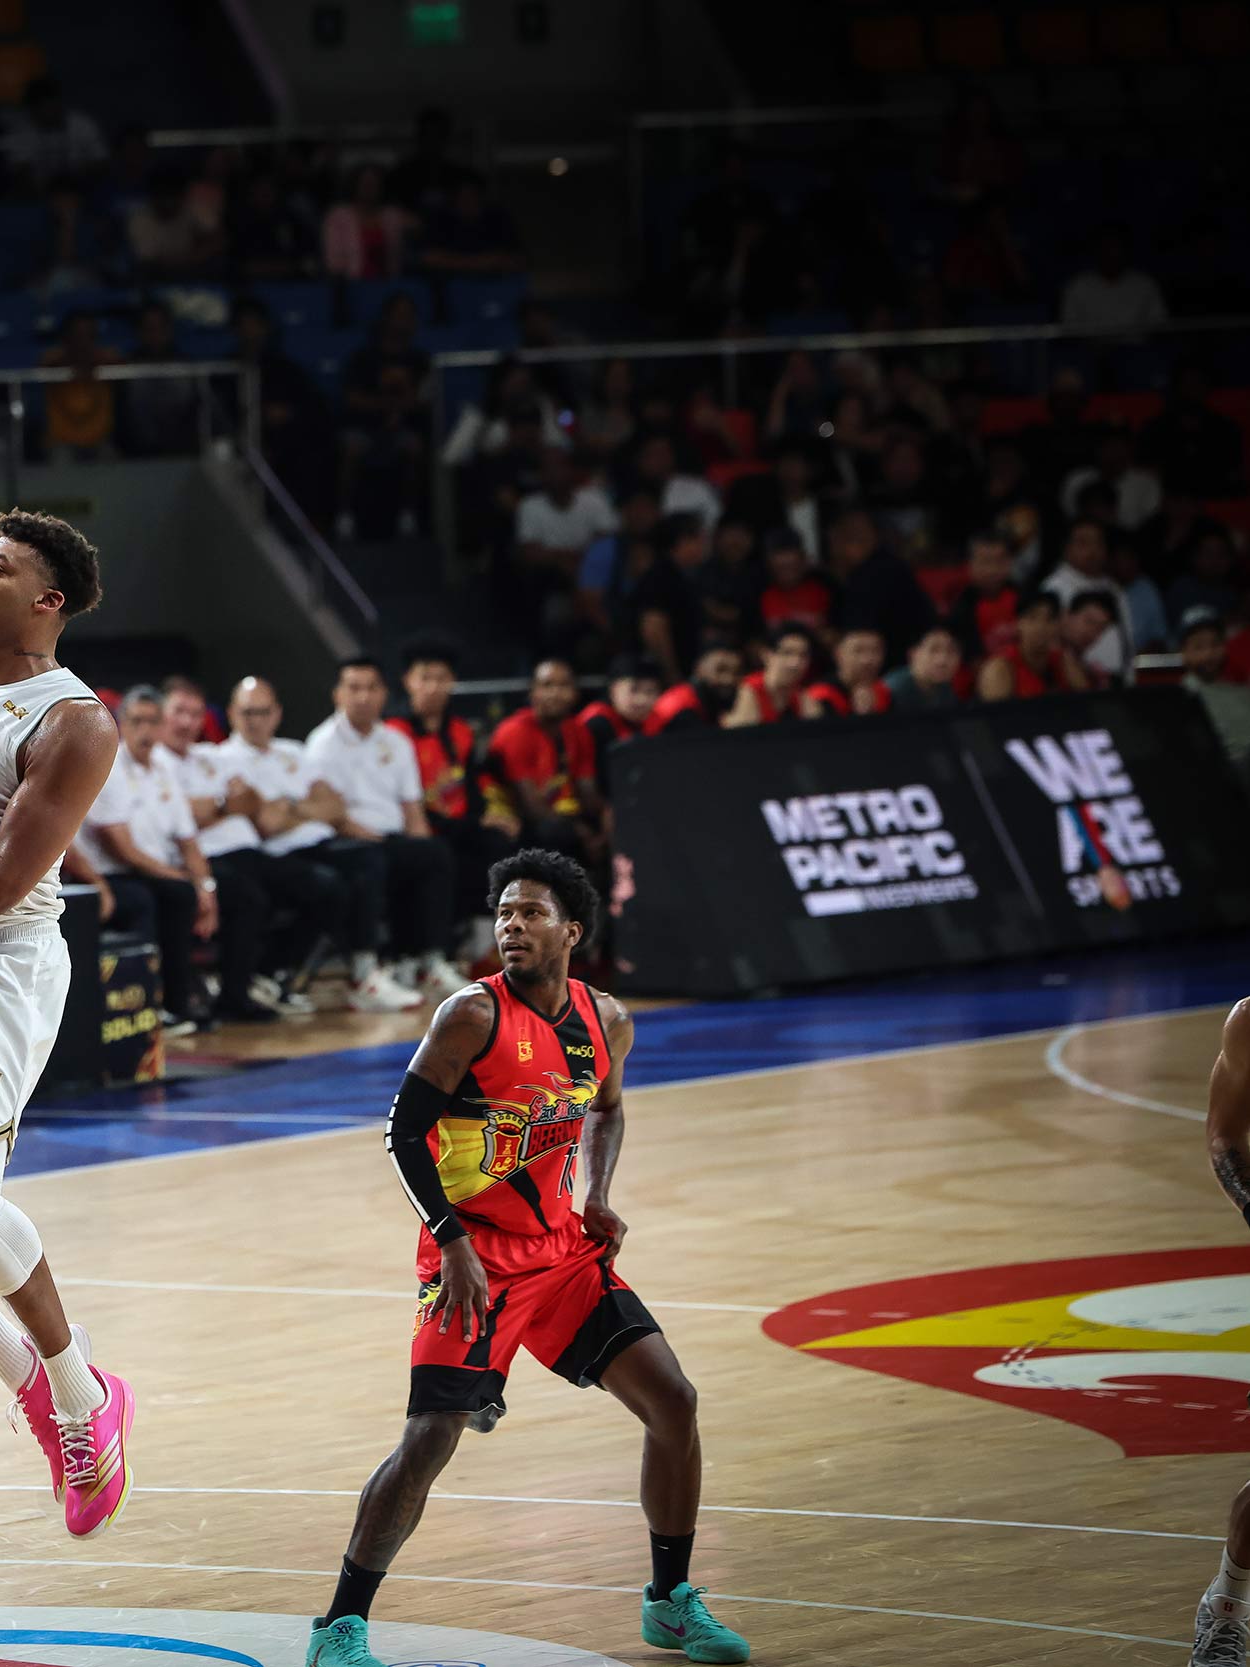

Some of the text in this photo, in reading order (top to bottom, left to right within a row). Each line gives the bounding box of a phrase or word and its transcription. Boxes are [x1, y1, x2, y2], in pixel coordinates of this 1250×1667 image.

[1004, 729, 1133, 802] WE
[760, 784, 944, 844] METRO
[1056, 796, 1164, 873] ARE
[781, 831, 964, 890] PACIFIC
